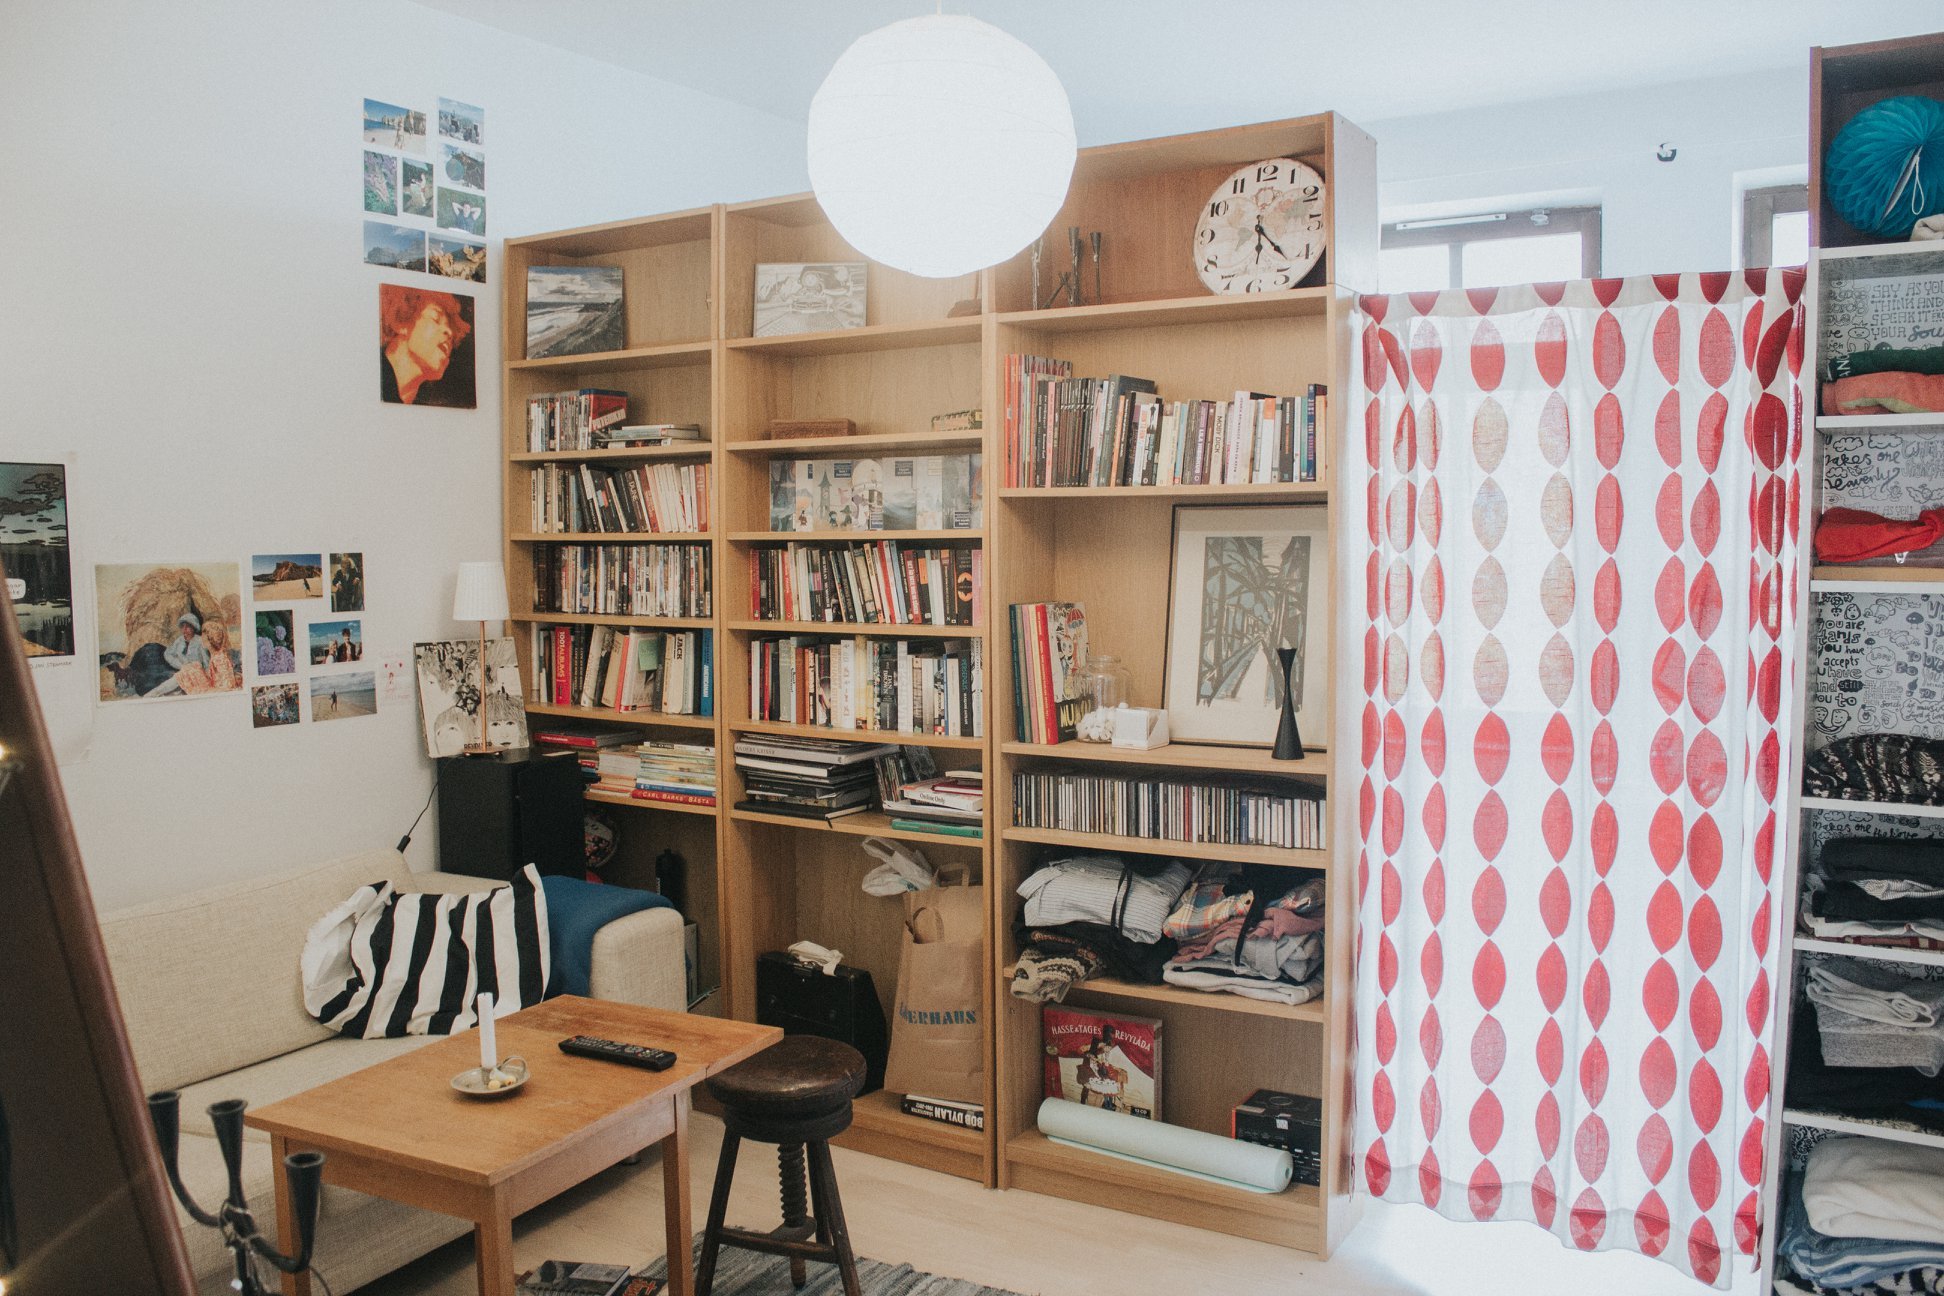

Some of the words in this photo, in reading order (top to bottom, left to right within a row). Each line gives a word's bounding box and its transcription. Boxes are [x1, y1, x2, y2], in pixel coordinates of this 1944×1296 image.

[1256, 165, 1278, 182] 12
[1290, 168, 1296, 184] 1
[1233, 178, 1245, 194] 11
[1303, 186, 1319, 202] 2
[1210, 200, 1228, 217] 10
[1307, 214, 1323, 231] 3
[1200, 229, 1215, 245] 9
[1296, 244, 1313, 259] 4
[1204, 255, 1218, 272] 8
[1274, 267, 1290, 285] 5
[1246, 279, 1262, 293] 6
[1871, 283, 1901, 298] SAY
[1906, 282, 1922, 296] AS
[1871, 299, 1914, 312] THINK
[1870, 312, 1915, 326] SPEAK
[1918, 311, 1930, 322] IT
[1871, 326, 1907, 340] YOUR
[1195, 443, 1203, 474] HIBISKUS
[1877, 452, 1901, 463] one
[629, 481, 639, 502] DUNE
[1845, 620, 1866, 631] are,
[1817, 646, 1841, 658] you
[1846, 646, 1864, 655] have
[1824, 656, 1859, 669] accepts
[1828, 667, 1862, 679] have
[1840, 681, 1859, 689] still
[1816, 694, 1832, 703] ou
[1835, 693, 1856, 707] to
[463, 741, 493, 750] REVOLER
[642, 791, 659, 799] CARL
[1052, 1024, 1102, 1036] HASSE&TAGES
[1114, 1030, 1151, 1052] REVYLÅDA
[934, 1107, 964, 1123] DYLAN
[964, 1113, 984, 1128] BOB
